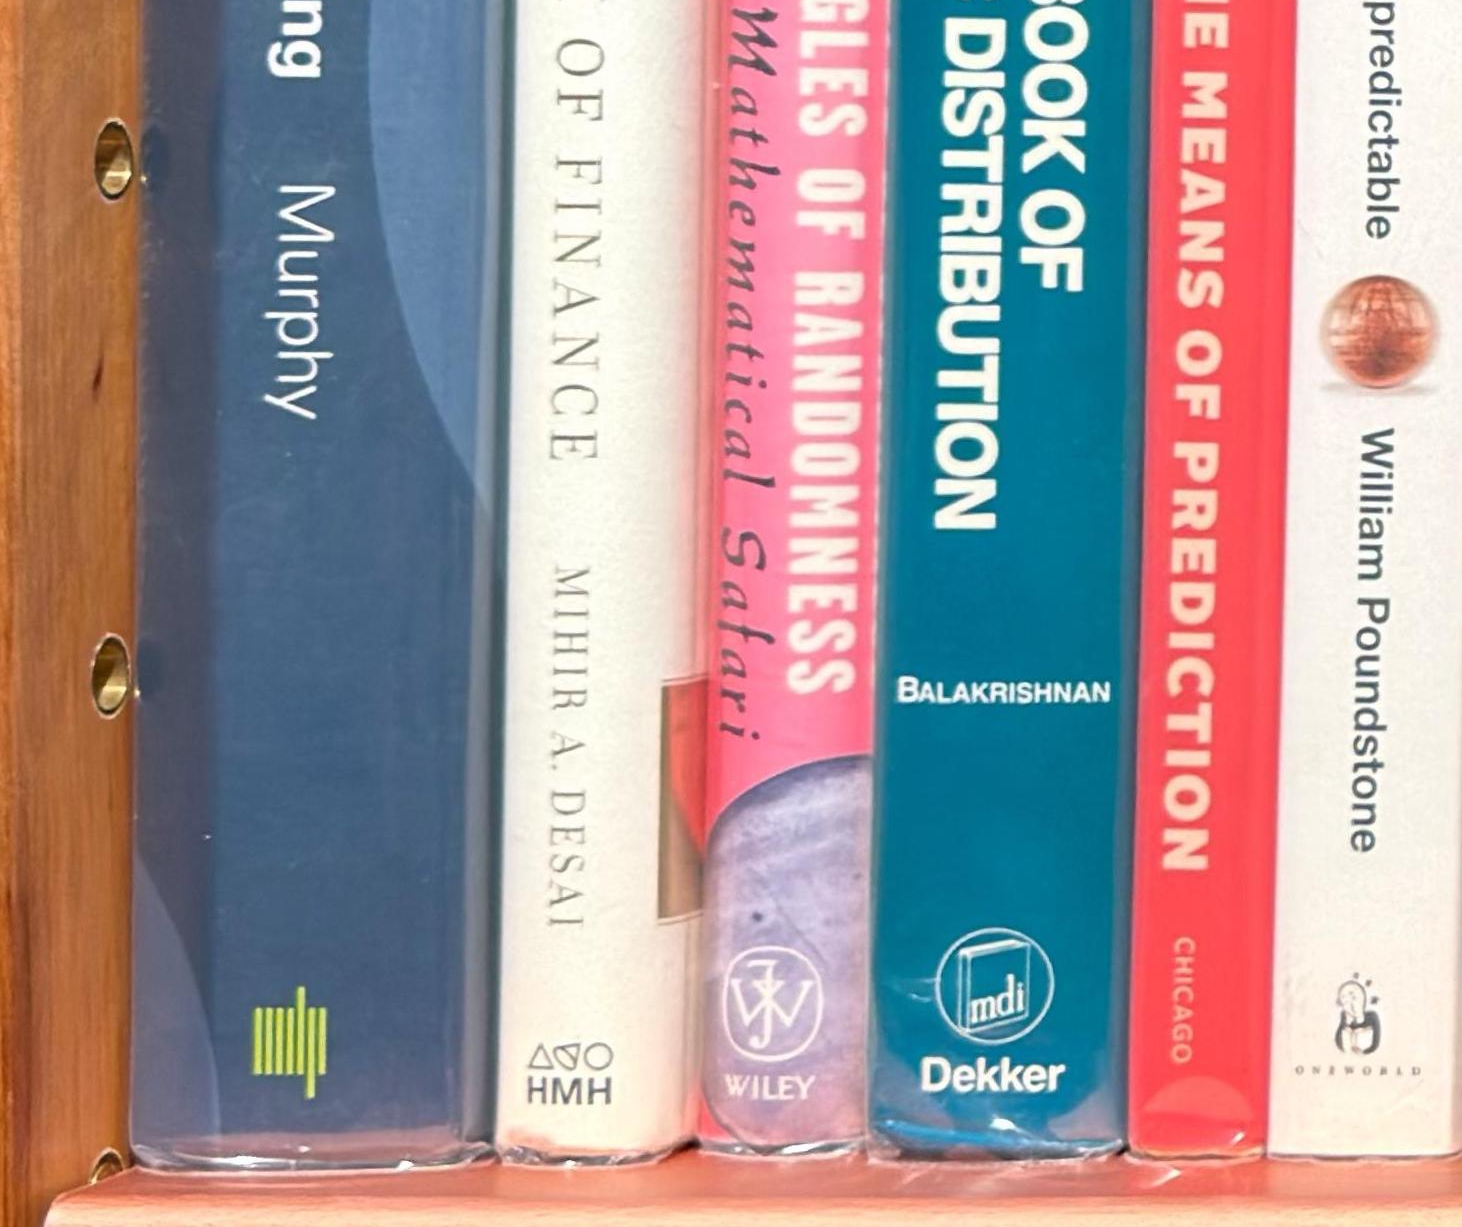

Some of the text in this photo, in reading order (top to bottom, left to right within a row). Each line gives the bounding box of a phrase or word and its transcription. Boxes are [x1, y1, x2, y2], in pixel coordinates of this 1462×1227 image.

[555, 39, 606, 123] OF
[722, 8, 780, 489] Mathematical
[799, 169, 863, 241] OF
[933, 18, 1008, 531] DISTRIBUTION
[1018, 191, 1087, 293] OF
[1174, 72, 1227, 308] MEANS
[263, 184, 336, 421] Murphy
[548, 156, 603, 464] FINANCE
[1172, 330, 1222, 420] OF
[786, 270, 863, 694] RANDOMNESS
[718, 527, 775, 740] Safari
[897, 675, 1110, 703] BALAKRISHNAN
[1161, 440, 1220, 872] PREDICTION
[1349, 427, 1395, 853] William Poundstone
[548, 566, 590, 927] MIHIR A. DESAI
[921, 1055, 1066, 1092] Dekker
[1170, 937, 1197, 1063] CHICAGO
[1295, 1064, 1421, 1077] ONEWORLD
[527, 1077, 613, 1106] HMH
[725, 1075, 815, 1101] WILEY
